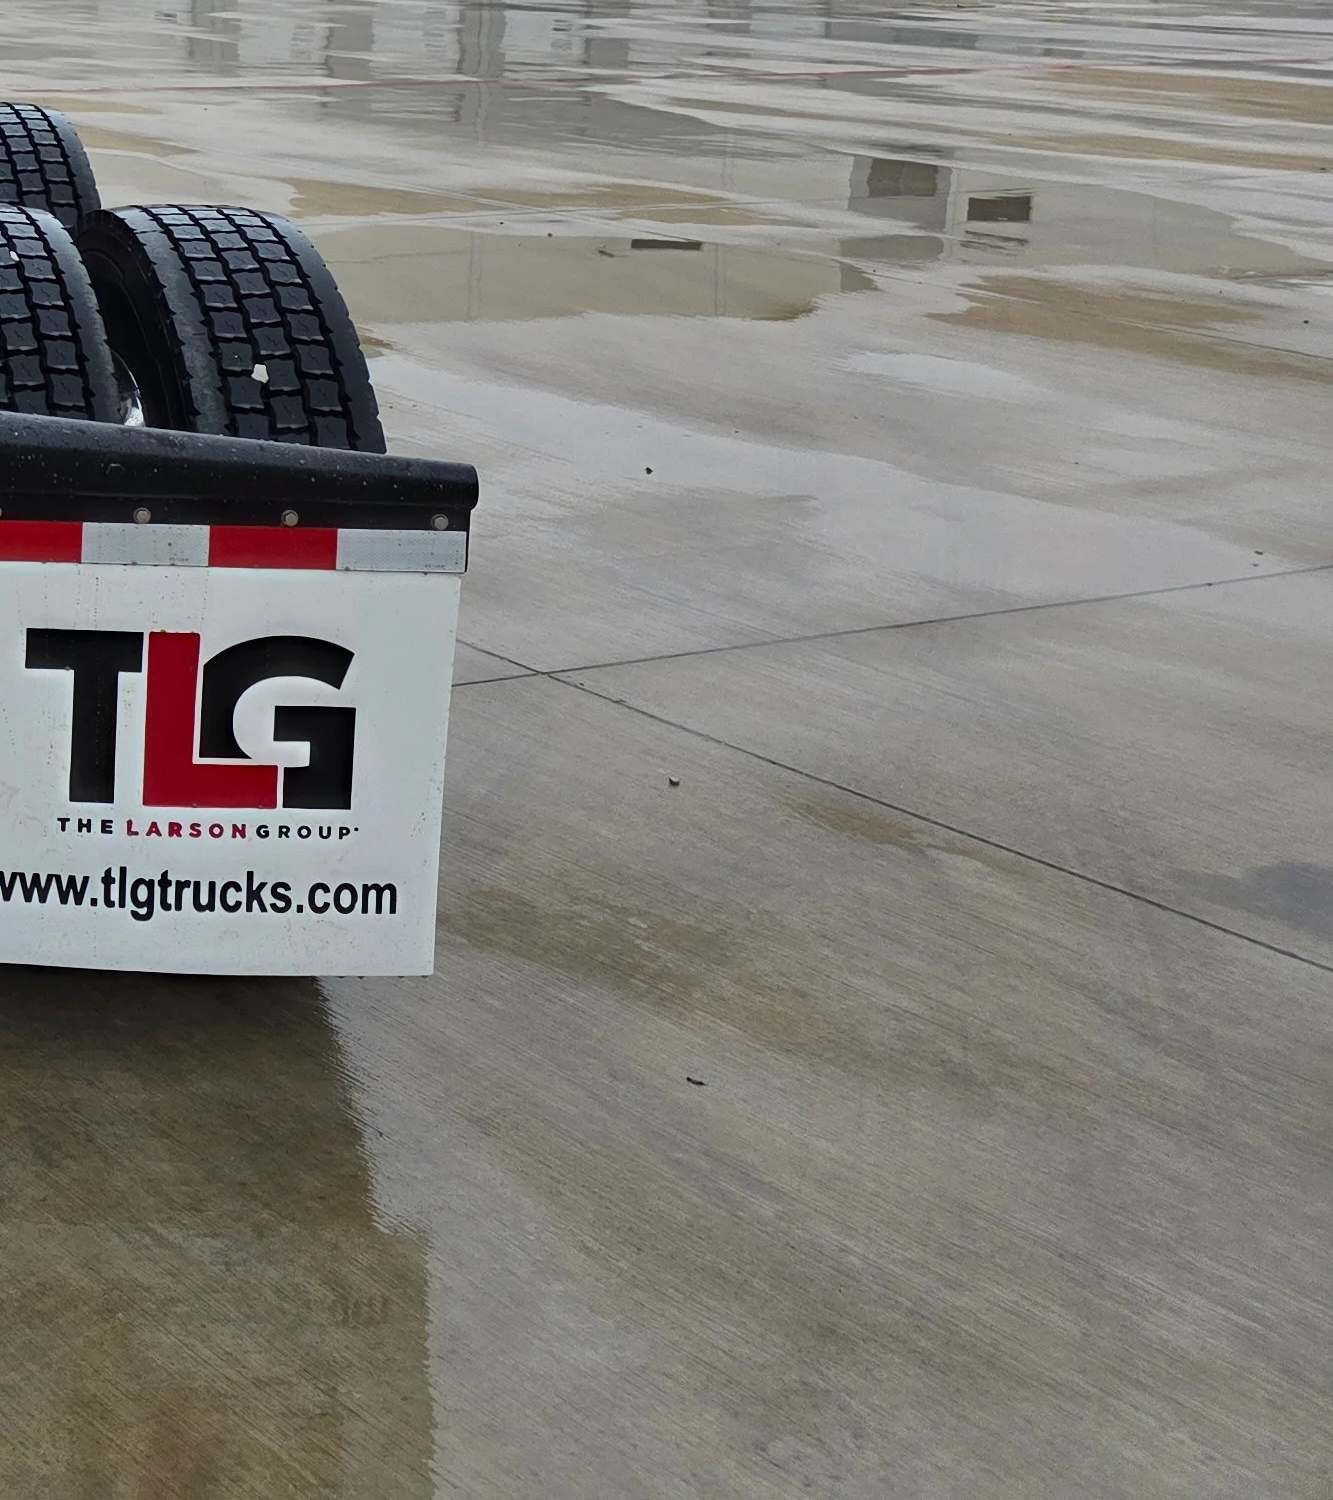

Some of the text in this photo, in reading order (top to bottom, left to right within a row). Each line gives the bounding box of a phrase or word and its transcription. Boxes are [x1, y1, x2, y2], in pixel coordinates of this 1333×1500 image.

[24, 627, 357, 810] TLG
[56, 817, 352, 840] THE LARSON GROUP
